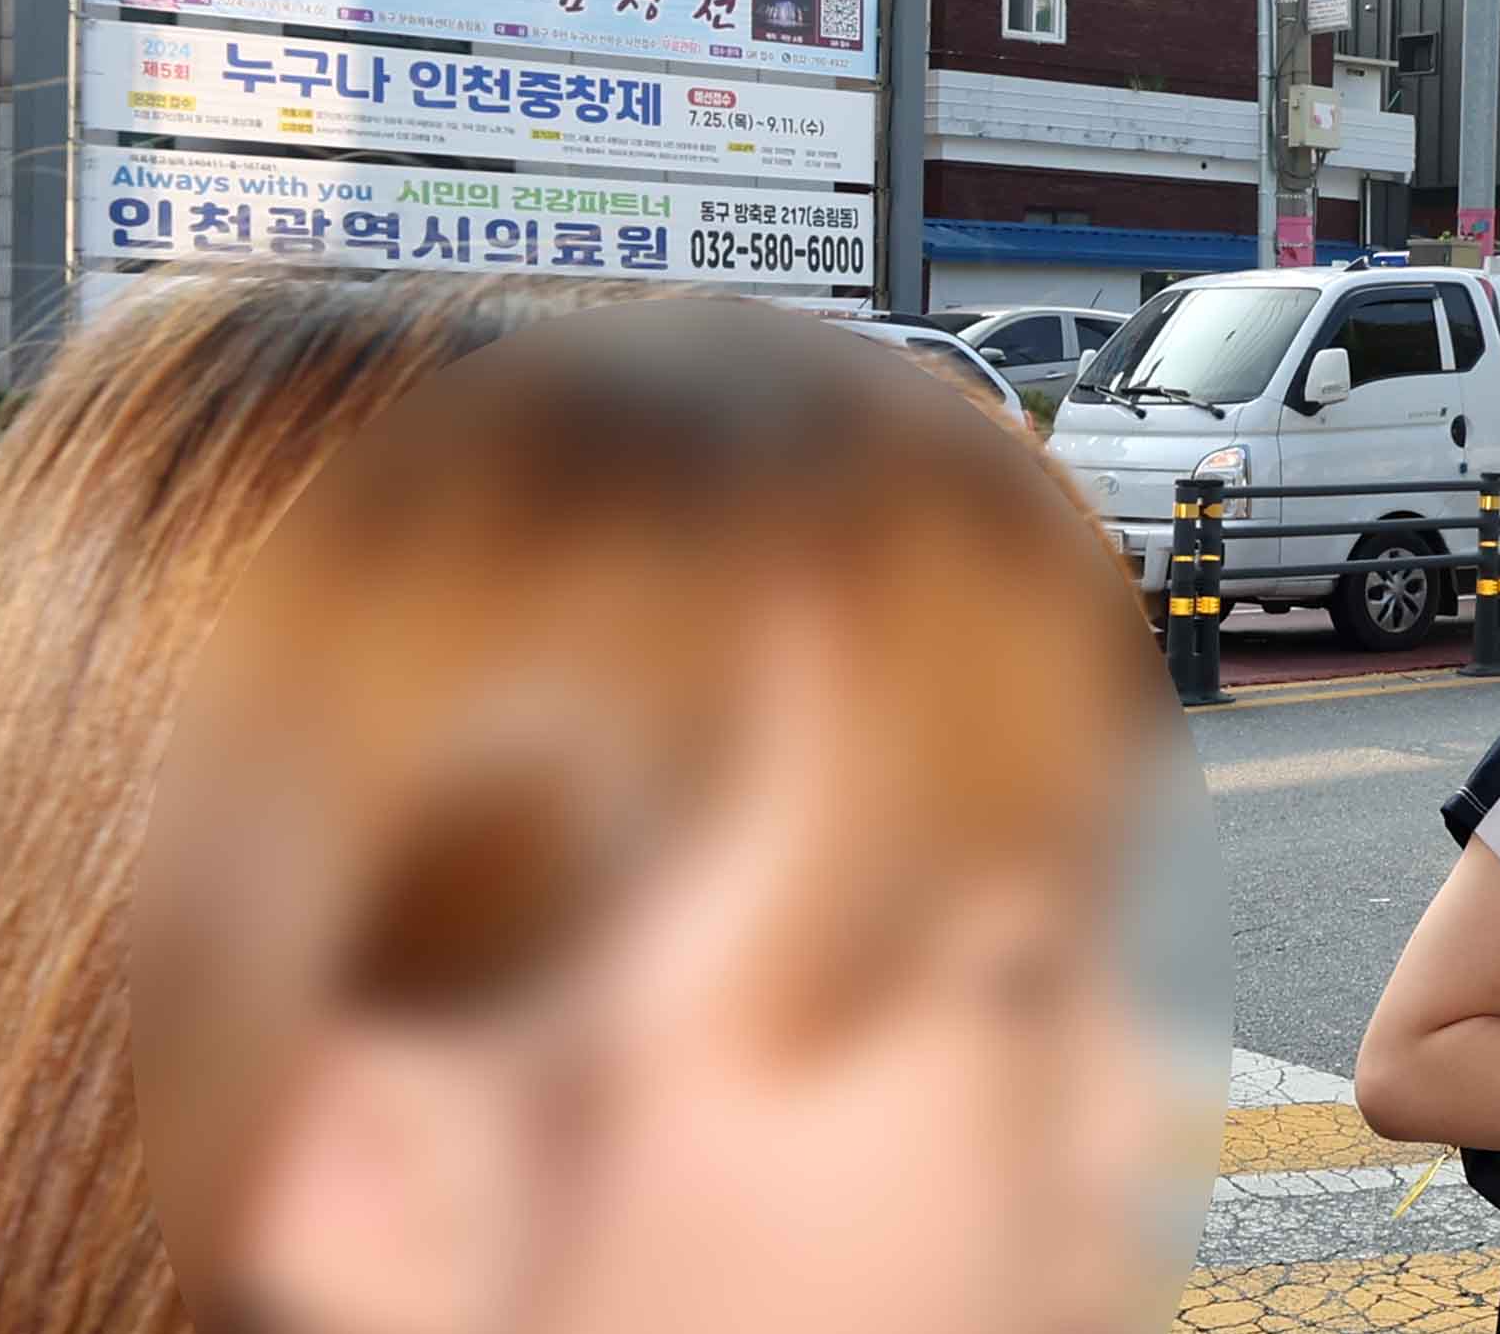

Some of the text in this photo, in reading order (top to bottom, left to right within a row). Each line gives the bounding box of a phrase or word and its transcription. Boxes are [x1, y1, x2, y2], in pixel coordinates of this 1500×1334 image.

[143, 38, 191, 57] 2024
[142, 60, 190, 81] 제5회
[222, 43, 391, 103] 누구나
[409, 61, 661, 127] 인천중창제
[112, 166, 670, 218] Always with you 시민의 건강파트너
[701, 201, 729, 222] 동구
[691, 230, 863, 274] 032-580-6000
